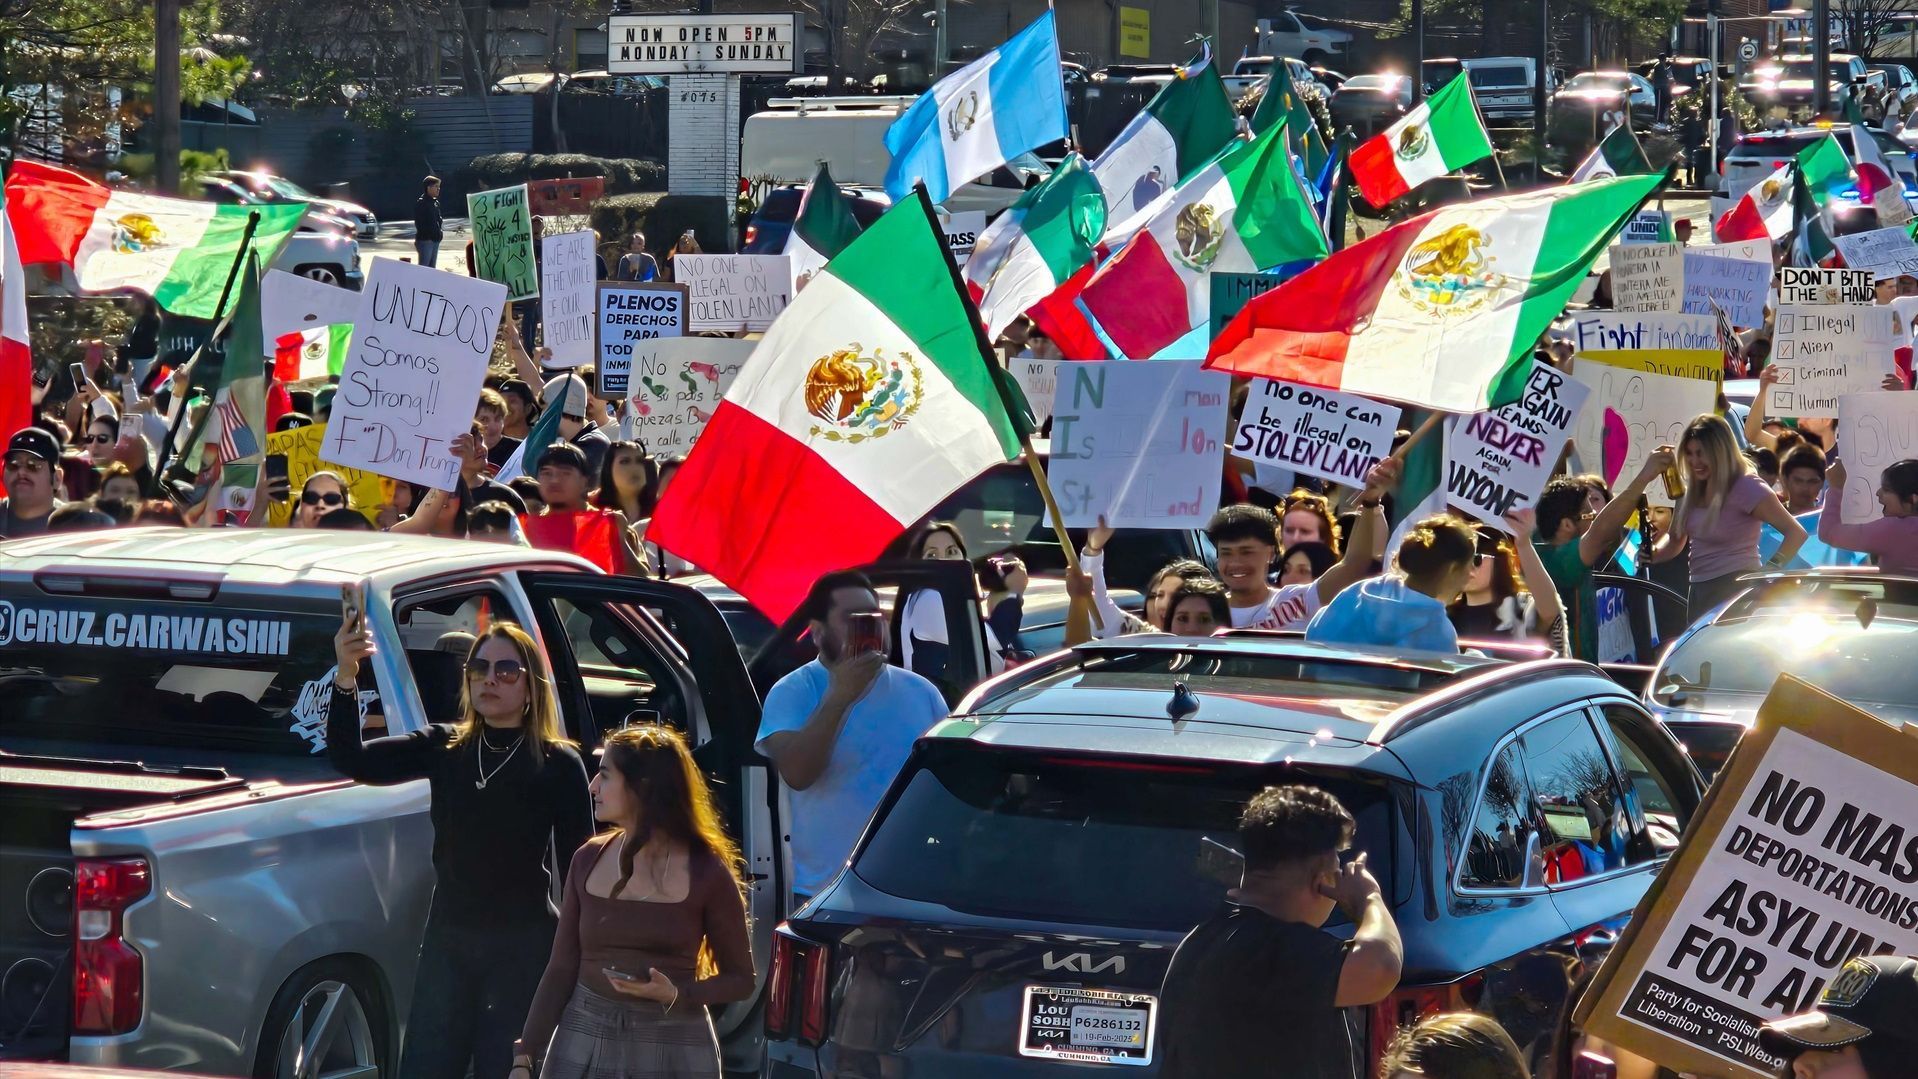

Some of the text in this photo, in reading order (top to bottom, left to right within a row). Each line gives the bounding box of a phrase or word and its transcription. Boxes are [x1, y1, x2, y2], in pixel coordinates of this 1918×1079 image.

[626, 26, 777, 42] NOW OPEN 5PM
[620, 44, 785, 61] MONDAY SUNDAY
[494, 189, 525, 210] FIGHT
[511, 208, 520, 231] 4
[546, 237, 588, 267] WE ARE
[678, 257, 763, 277] NO ONE IS
[544, 270, 565, 293] THE
[690, 275, 767, 298] LLEGAL ON
[1841, 270, 1875, 287] BITE
[606, 294, 678, 312] PLENOS
[1783, 286, 1876, 303] THE HAND
[372, 281, 494, 355] UNIDOS
[606, 313, 678, 327] DERECHOS
[690, 299, 735, 321] TOLEN
[623, 329, 660, 341] PARA
[1577, 319, 1648, 351] Fight
[1798, 313, 1855, 335] Illegal
[360, 335, 441, 375] Somos
[604, 344, 633, 356] TOD
[1799, 340, 1834, 355] Alien
[640, 352, 667, 376] No
[1027, 363, 1044, 375] NO
[1799, 363, 1847, 380] Criminal
[343, 370, 441, 427] Strong!!
[1264, 380, 1382, 428] no one can
[657, 429, 681, 446] calle
[1259, 406, 1372, 455] be illegal on
[1464, 412, 1546, 468] NEVER
[1234, 424, 1323, 469] STOLEN
[413, 434, 460, 484] Trump
[1481, 461, 1501, 475] FOR
[1747, 769, 1826, 836] NO
[1042, 950, 1126, 975] KIA
[1666, 923, 1768, 1000] FOR
[1761, 966, 1826, 1015] AL
[1038, 1004, 1069, 1015] LOU
[1645, 982, 1680, 1009] Party
[1682, 994, 1702, 1016] for
[1032, 1015, 1071, 1027] SOBH
[1074, 1017, 1141, 1031] P6286132
[1636, 999, 1702, 1036] Liberation
